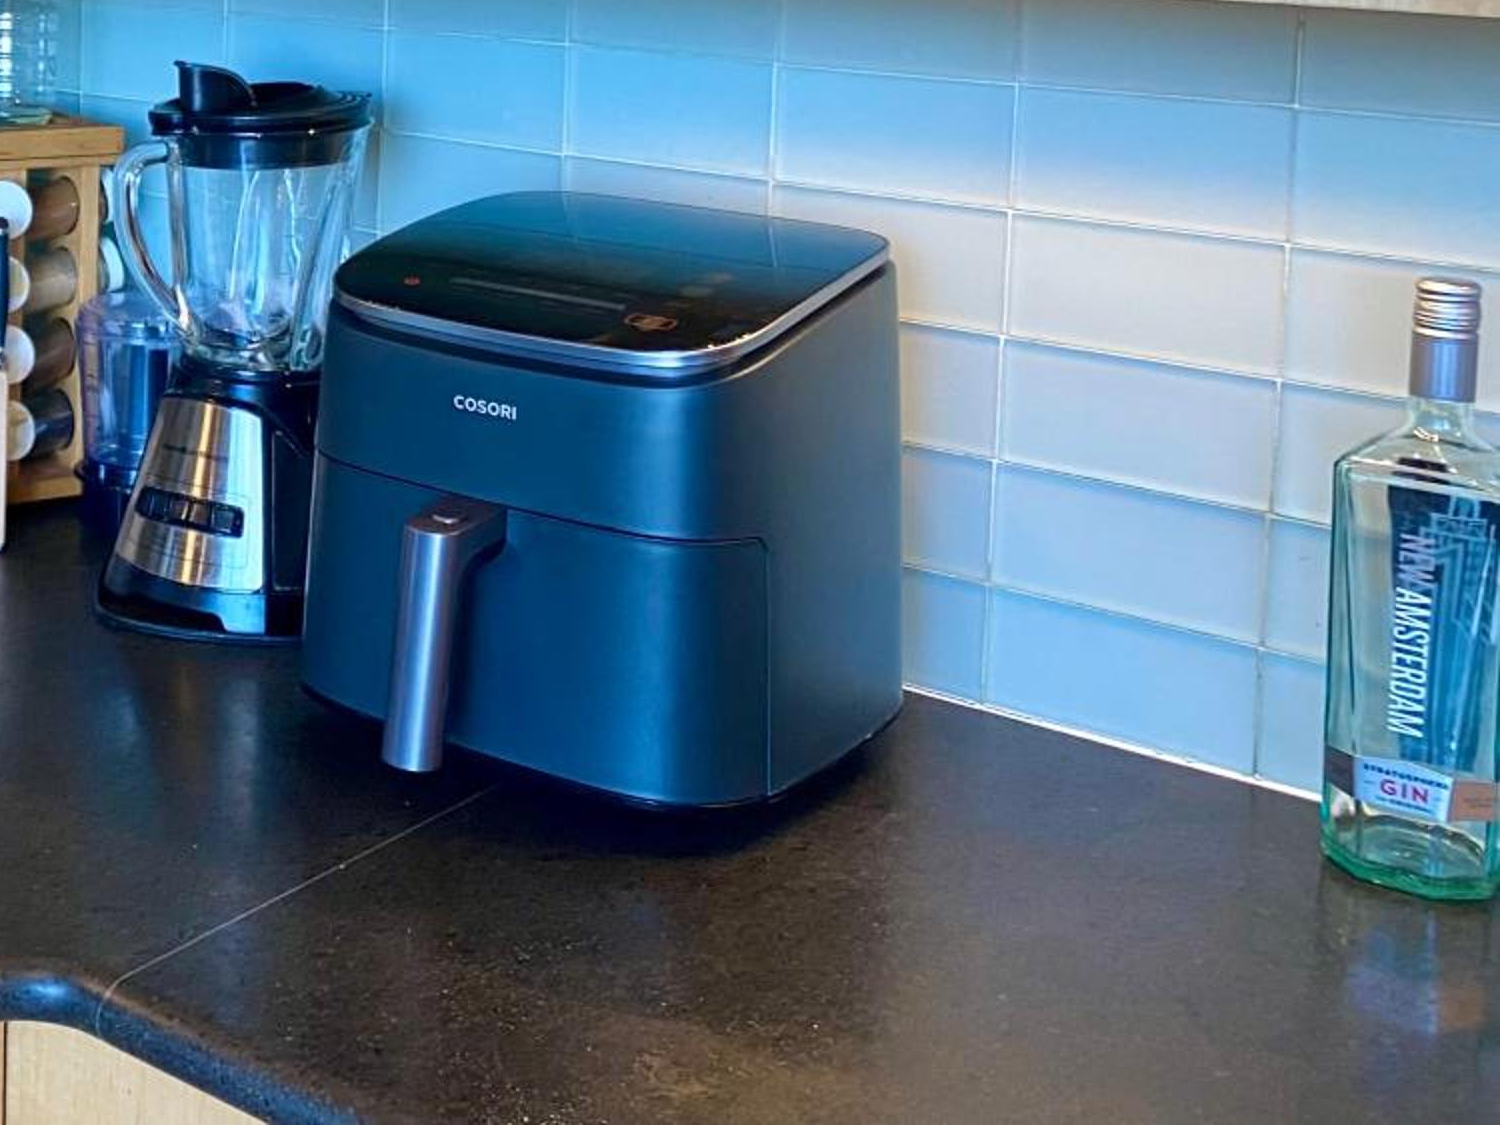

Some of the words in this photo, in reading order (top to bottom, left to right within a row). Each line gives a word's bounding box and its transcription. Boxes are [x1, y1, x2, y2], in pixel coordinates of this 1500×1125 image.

[453, 394, 518, 421] COSORI
[1398, 532, 1436, 583] NEW
[1386, 586, 1433, 739] AMSTERDAM
[1380, 778, 1429, 804] GIN
